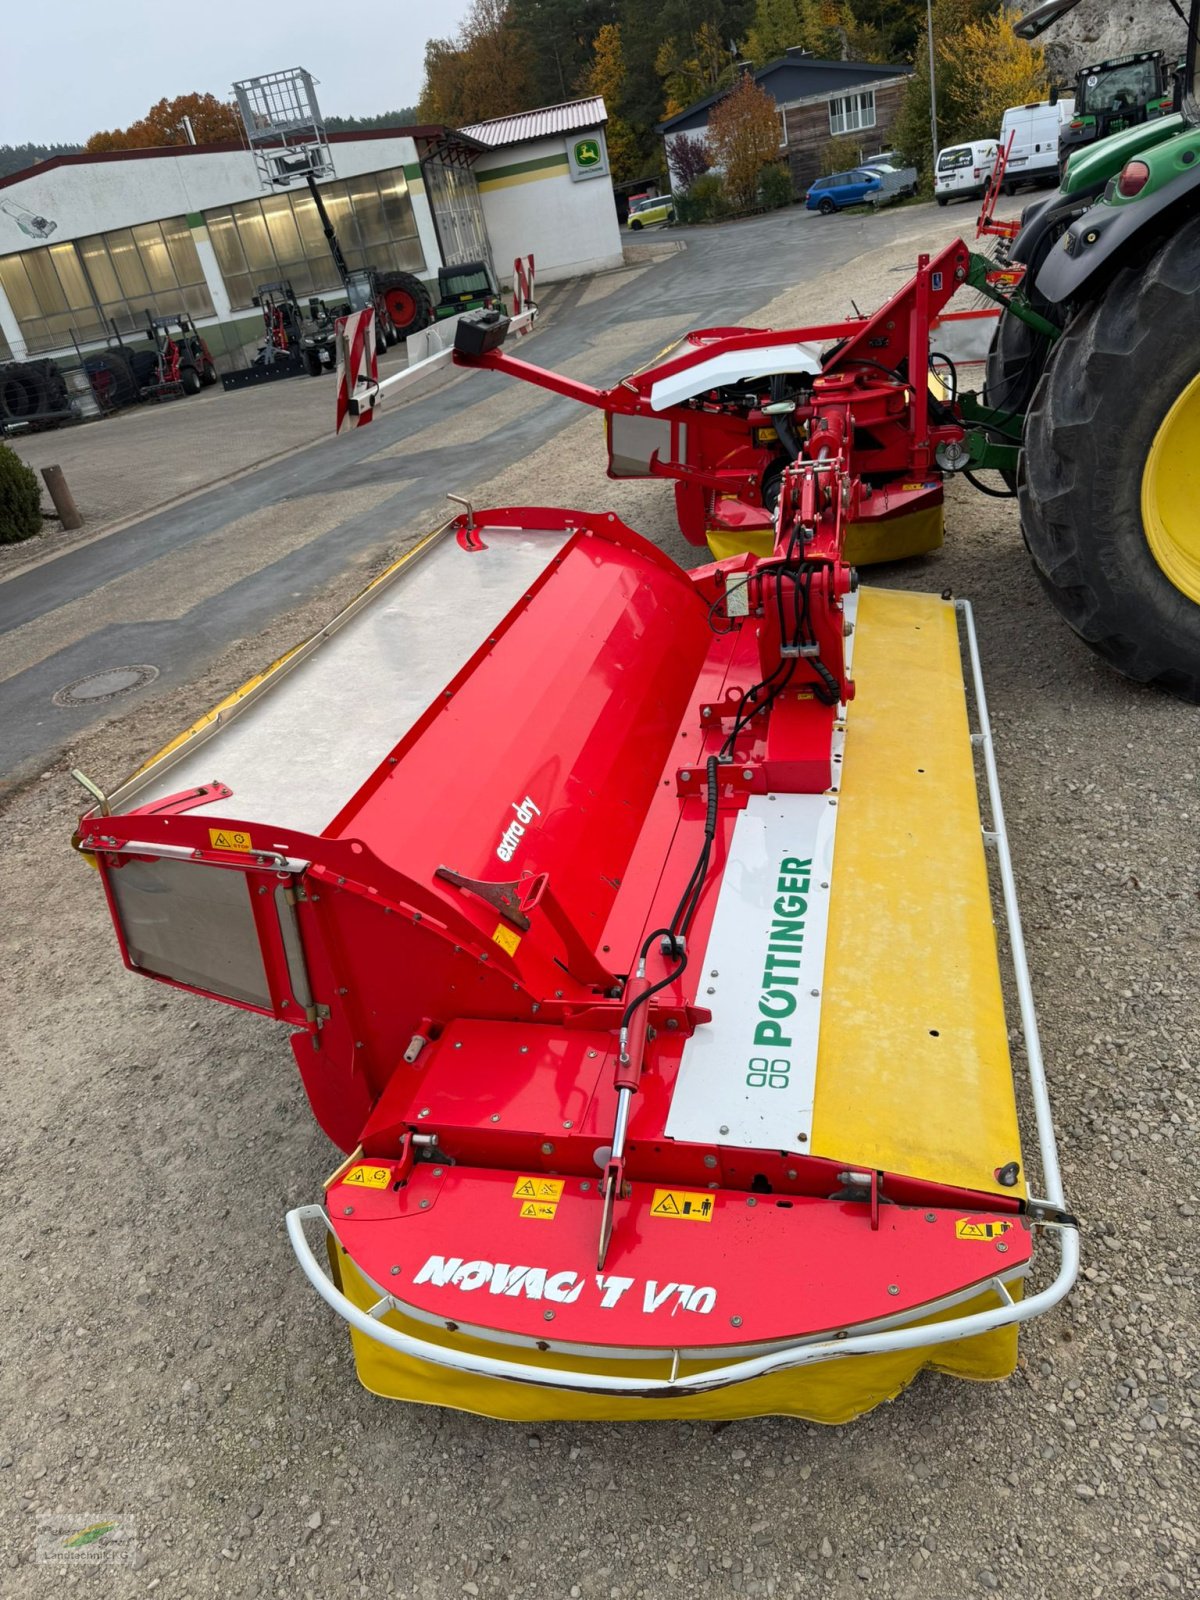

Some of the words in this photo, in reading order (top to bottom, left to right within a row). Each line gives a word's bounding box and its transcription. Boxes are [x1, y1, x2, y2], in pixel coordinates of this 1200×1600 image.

[496, 820, 526, 862] extra
[511, 795, 541, 824] dry
[753, 857, 812, 1047] PÖTTINGER
[413, 1255, 636, 1308] NOVACT
[643, 1280, 717, 1316] V10
